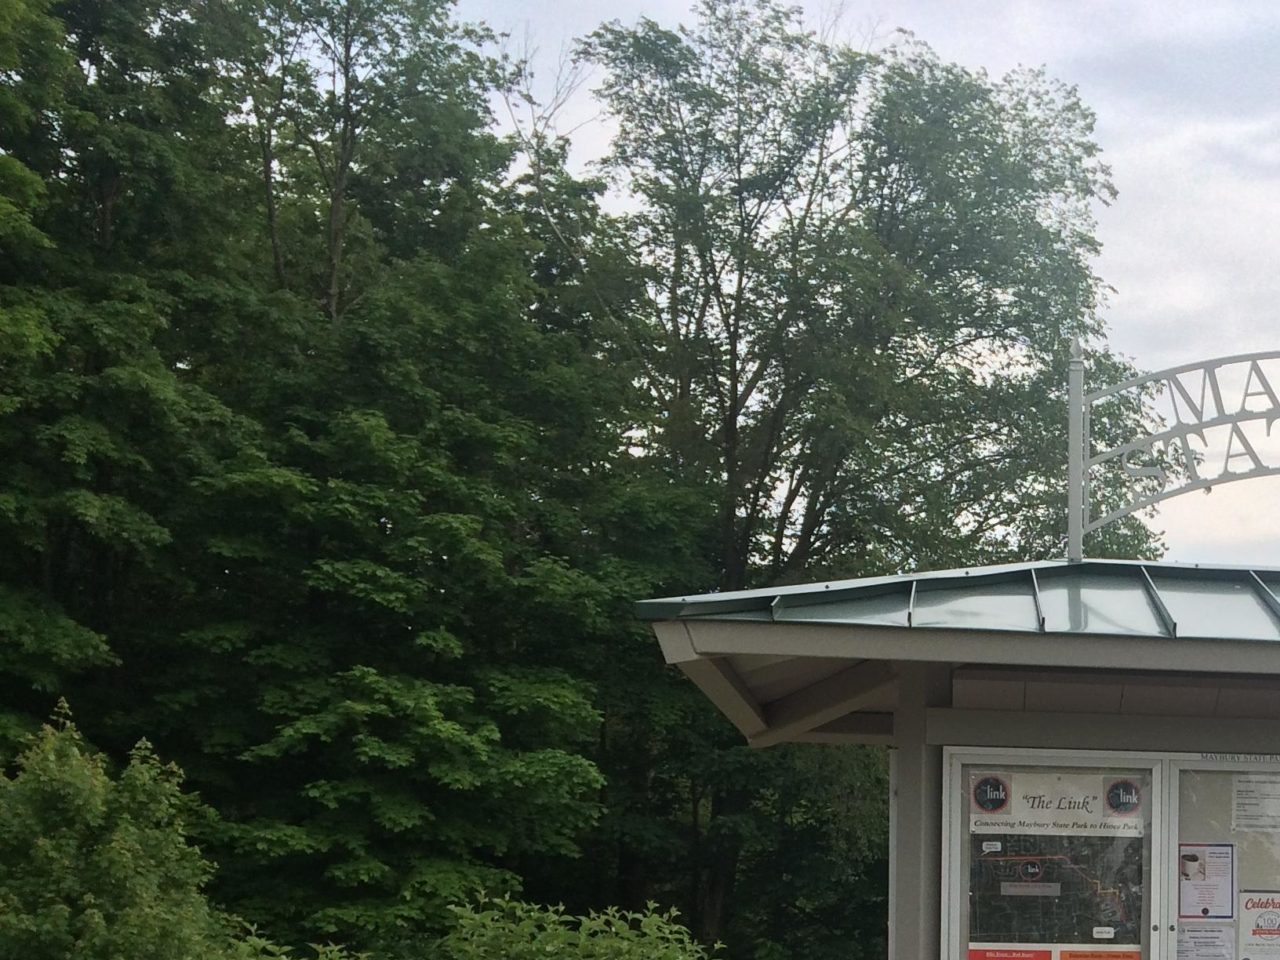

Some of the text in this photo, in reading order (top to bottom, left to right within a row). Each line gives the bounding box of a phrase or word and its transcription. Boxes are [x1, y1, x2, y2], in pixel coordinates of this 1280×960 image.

[1201, 753, 1239, 762] MAYBURY
[986, 785, 1005, 800] link
[1119, 789, 1138, 804] link
[974, 819, 1016, 828] Connecting
[1017, 820, 1050, 829] Maybury
[1072, 821, 1087, 829] Park
